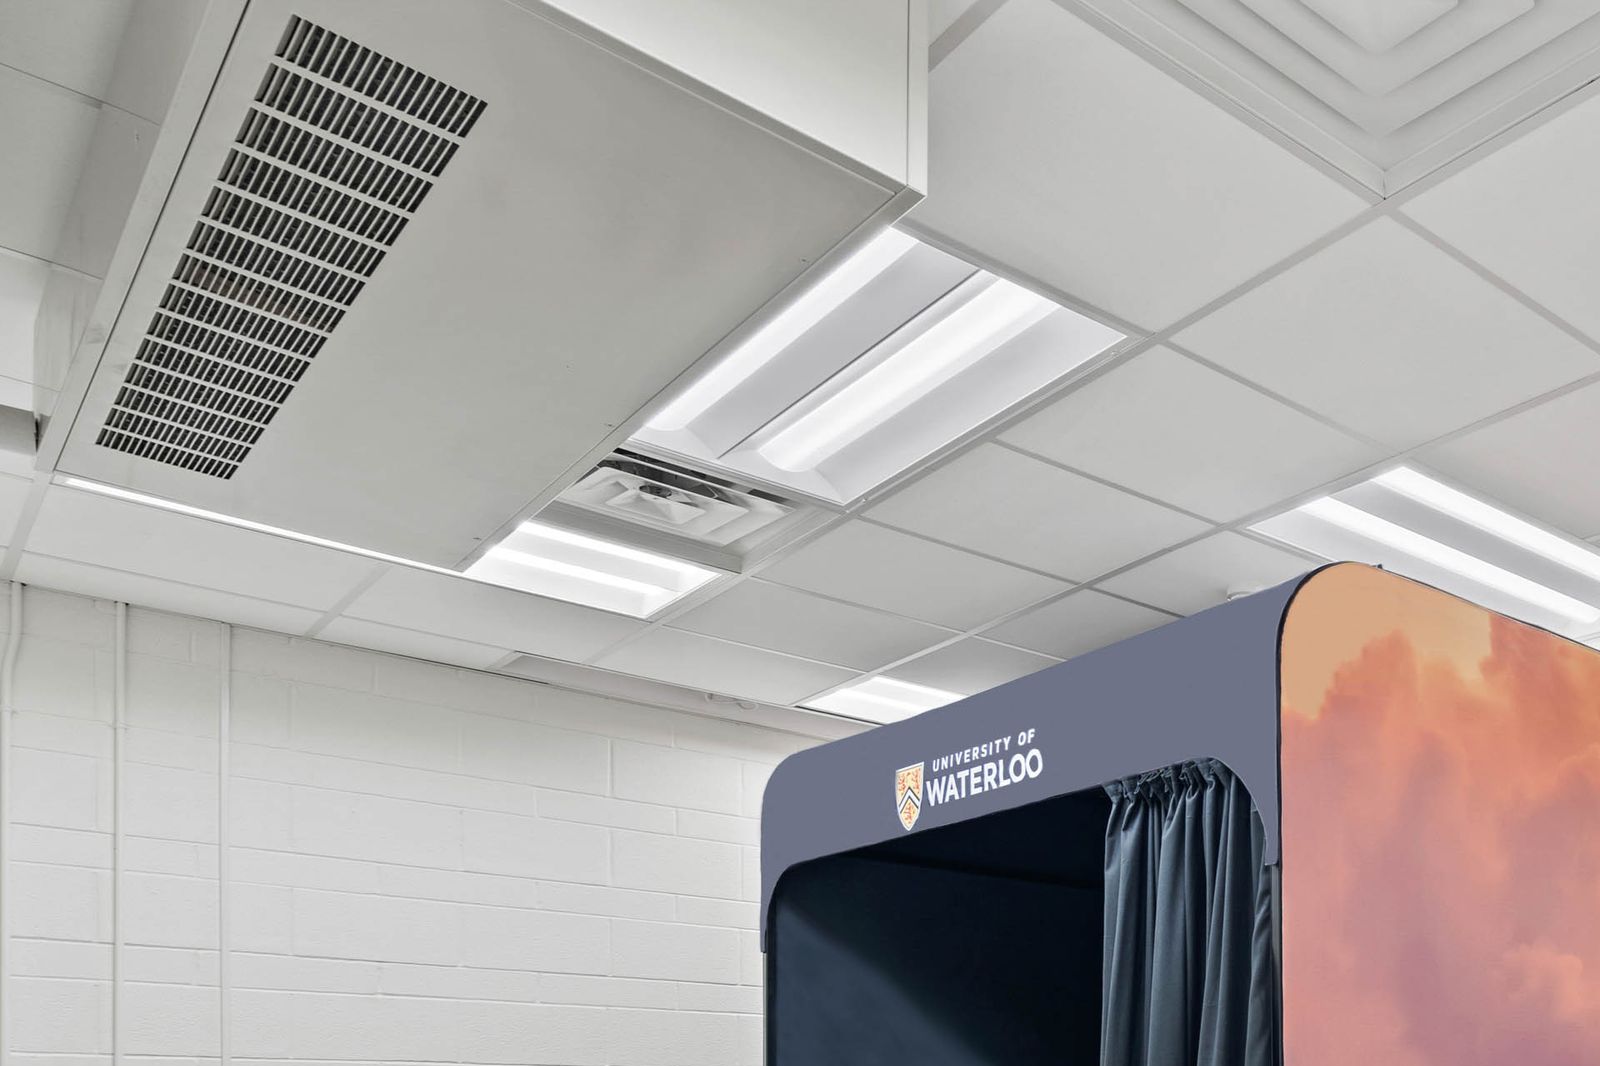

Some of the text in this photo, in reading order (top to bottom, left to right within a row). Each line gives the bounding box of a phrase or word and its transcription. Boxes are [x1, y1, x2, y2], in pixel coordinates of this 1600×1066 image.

[932, 728, 1036, 772] UNIVERSITY OF
[925, 748, 1043, 807] WATERLOO
